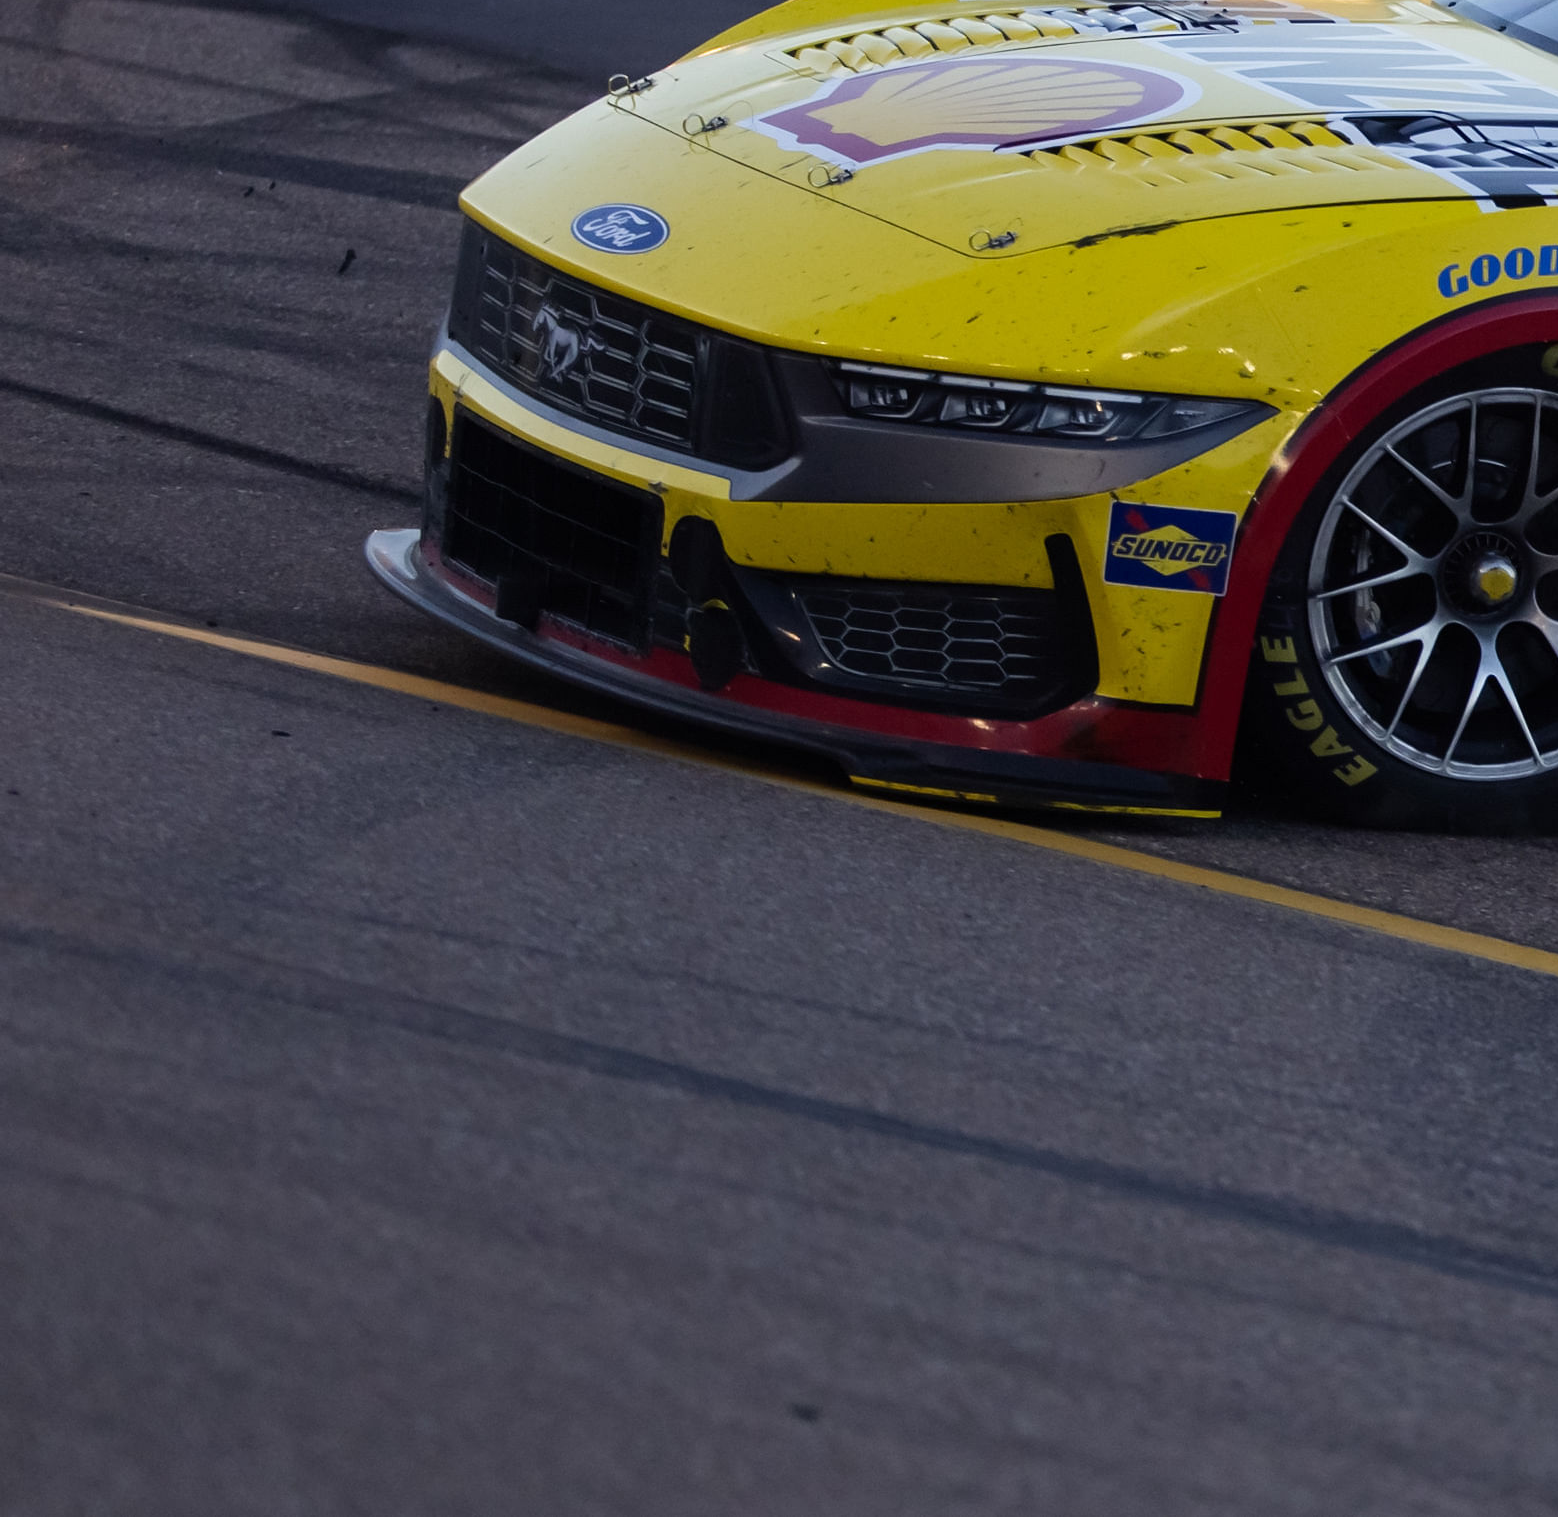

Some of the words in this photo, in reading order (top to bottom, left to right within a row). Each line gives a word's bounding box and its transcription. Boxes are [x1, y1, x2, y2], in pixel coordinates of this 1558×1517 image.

[582, 209, 651, 247] Ford
[1115, 536, 1224, 564] SUNOCO
[1261, 635, 1379, 786] EAGLE
